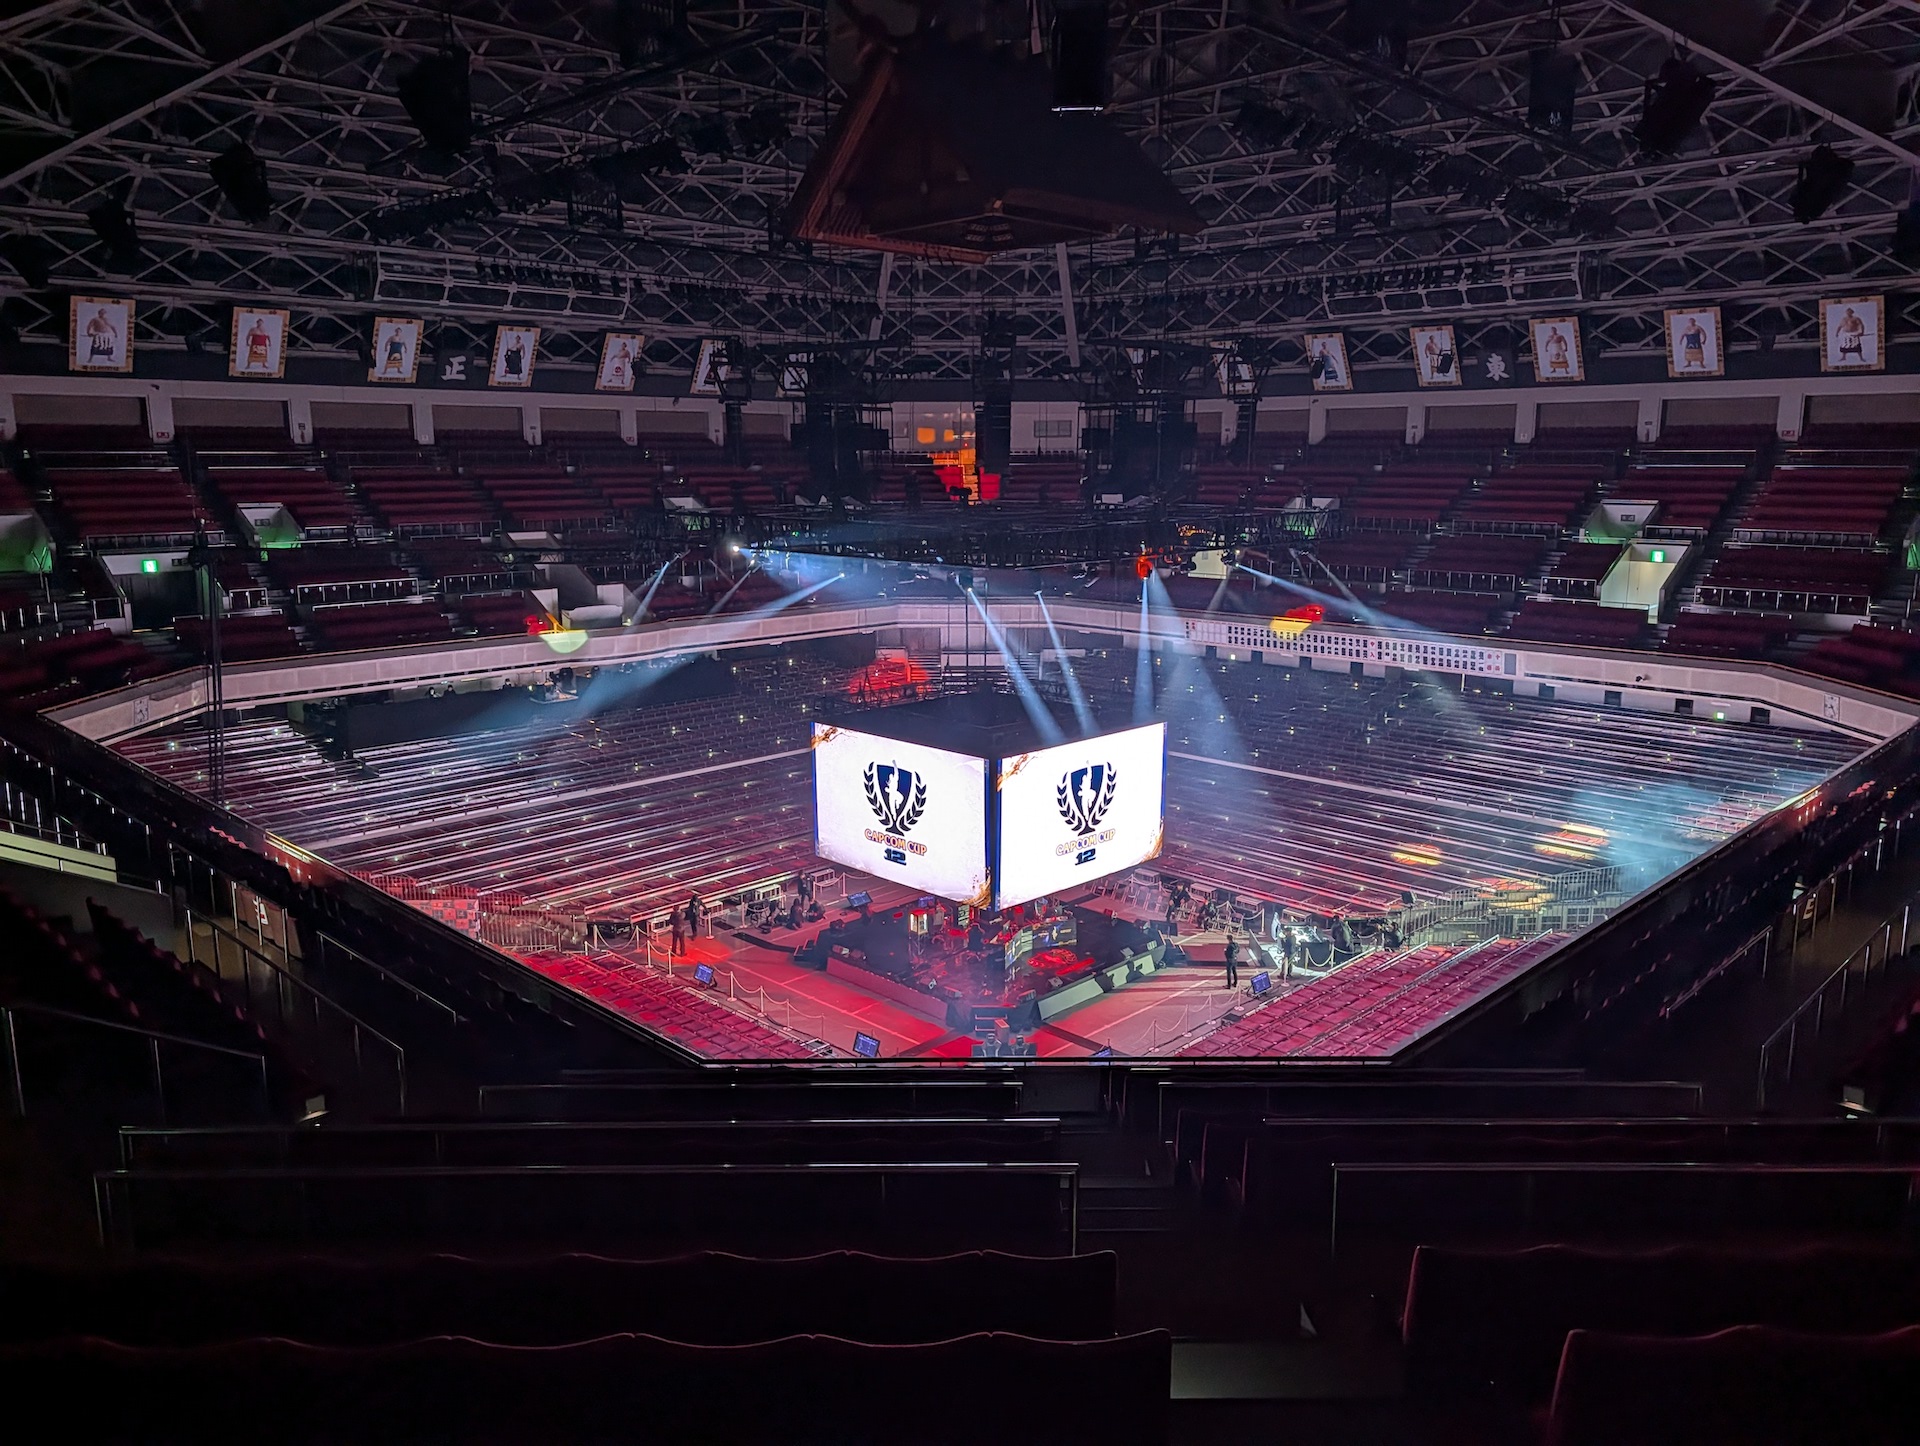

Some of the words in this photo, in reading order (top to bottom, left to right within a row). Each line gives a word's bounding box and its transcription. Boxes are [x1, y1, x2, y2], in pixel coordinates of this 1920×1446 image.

[441, 355, 467, 381] 正
[1485, 353, 1510, 382] 東
[864, 828, 907, 851] CAPCOM
[907, 840, 927, 857] CUP
[1055, 835, 1097, 857] CAPCOM
[1097, 828, 1116, 843] CUP
[883, 848, 907, 866] 12
[1074, 848, 1097, 866] 12
